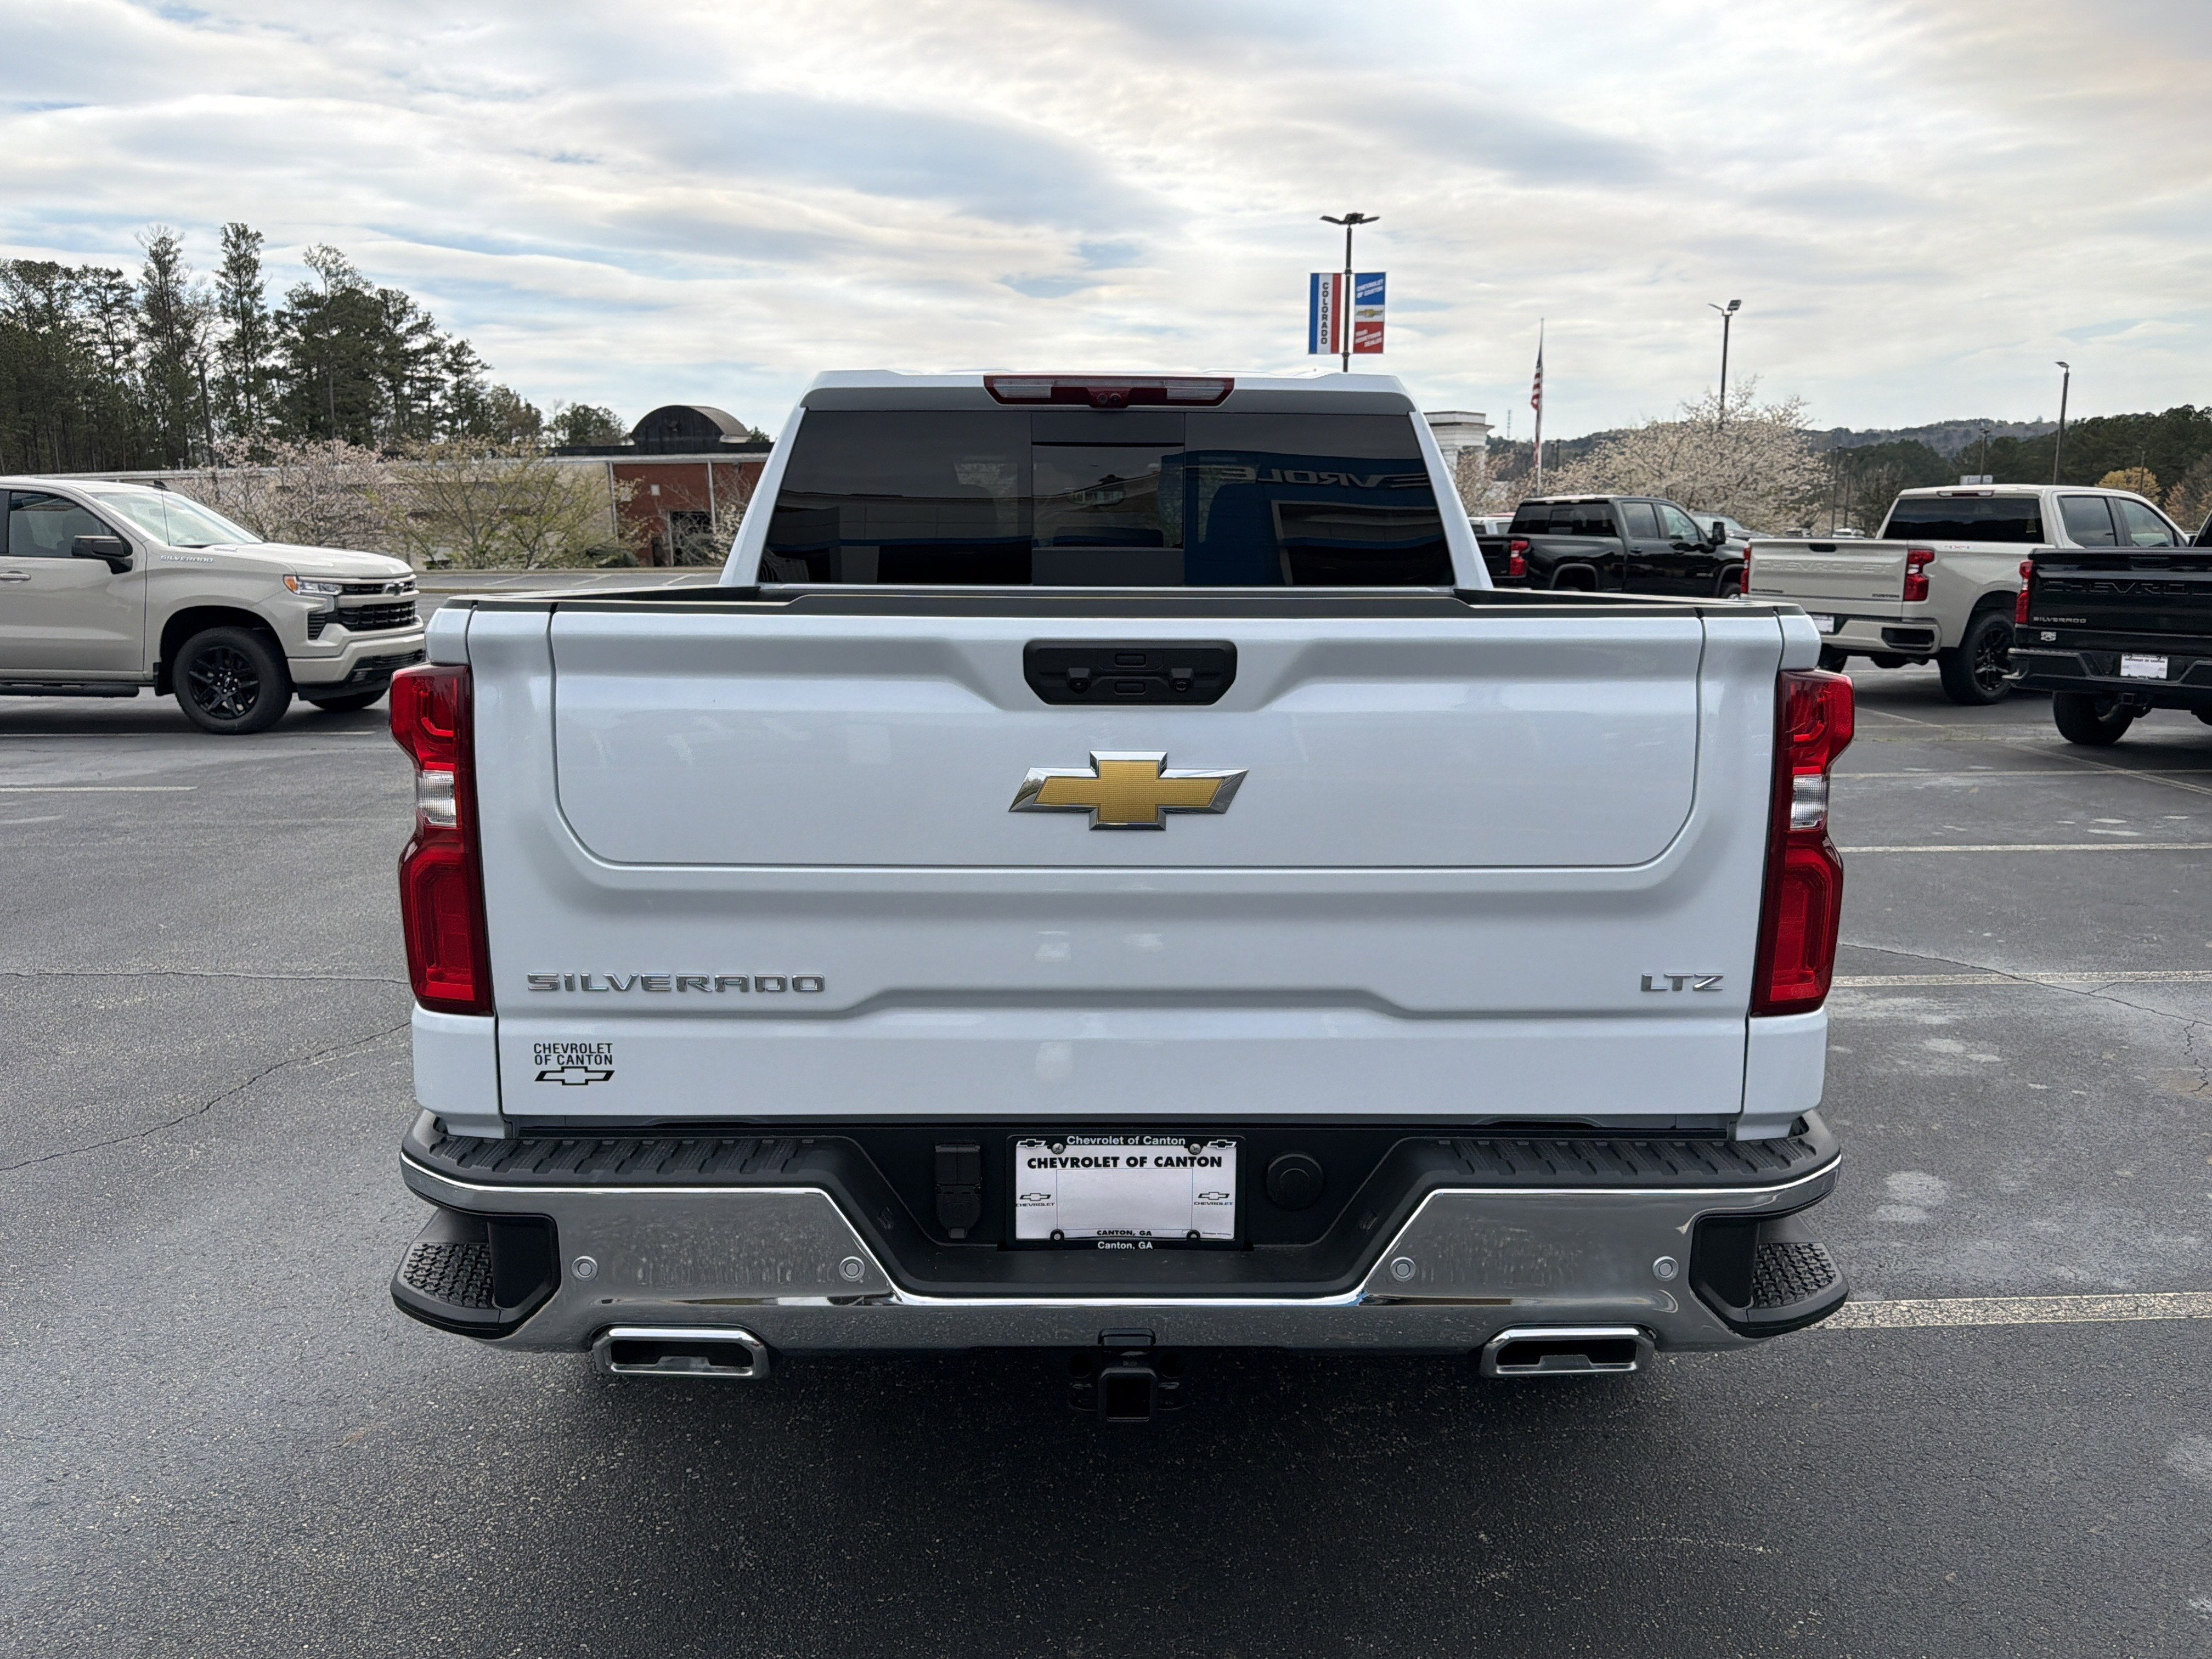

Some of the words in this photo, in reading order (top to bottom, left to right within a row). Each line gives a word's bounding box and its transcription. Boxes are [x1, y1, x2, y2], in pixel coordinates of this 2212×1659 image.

[1321, 282, 1329, 345] COLORADO
[527, 973, 825, 993] SILVERADO
[1640, 973, 1724, 991] LTZ
[534, 1043, 613, 1054] CHEVROLET
[534, 1054, 551, 1065] OF
[557, 1054, 613, 1065] CANTON
[1066, 1136, 1124, 1145] Chevrolet
[1128, 1136, 1139, 1145] of
[1143, 1136, 1186, 1146] Canton
[1027, 1156, 1119, 1169] CHEVROLET
[1126, 1156, 1147, 1167] OF
[1154, 1156, 1222, 1167] CANTON
[1097, 1242, 1135, 1250] Canton,
[1138, 1242, 1153, 1250] GA
